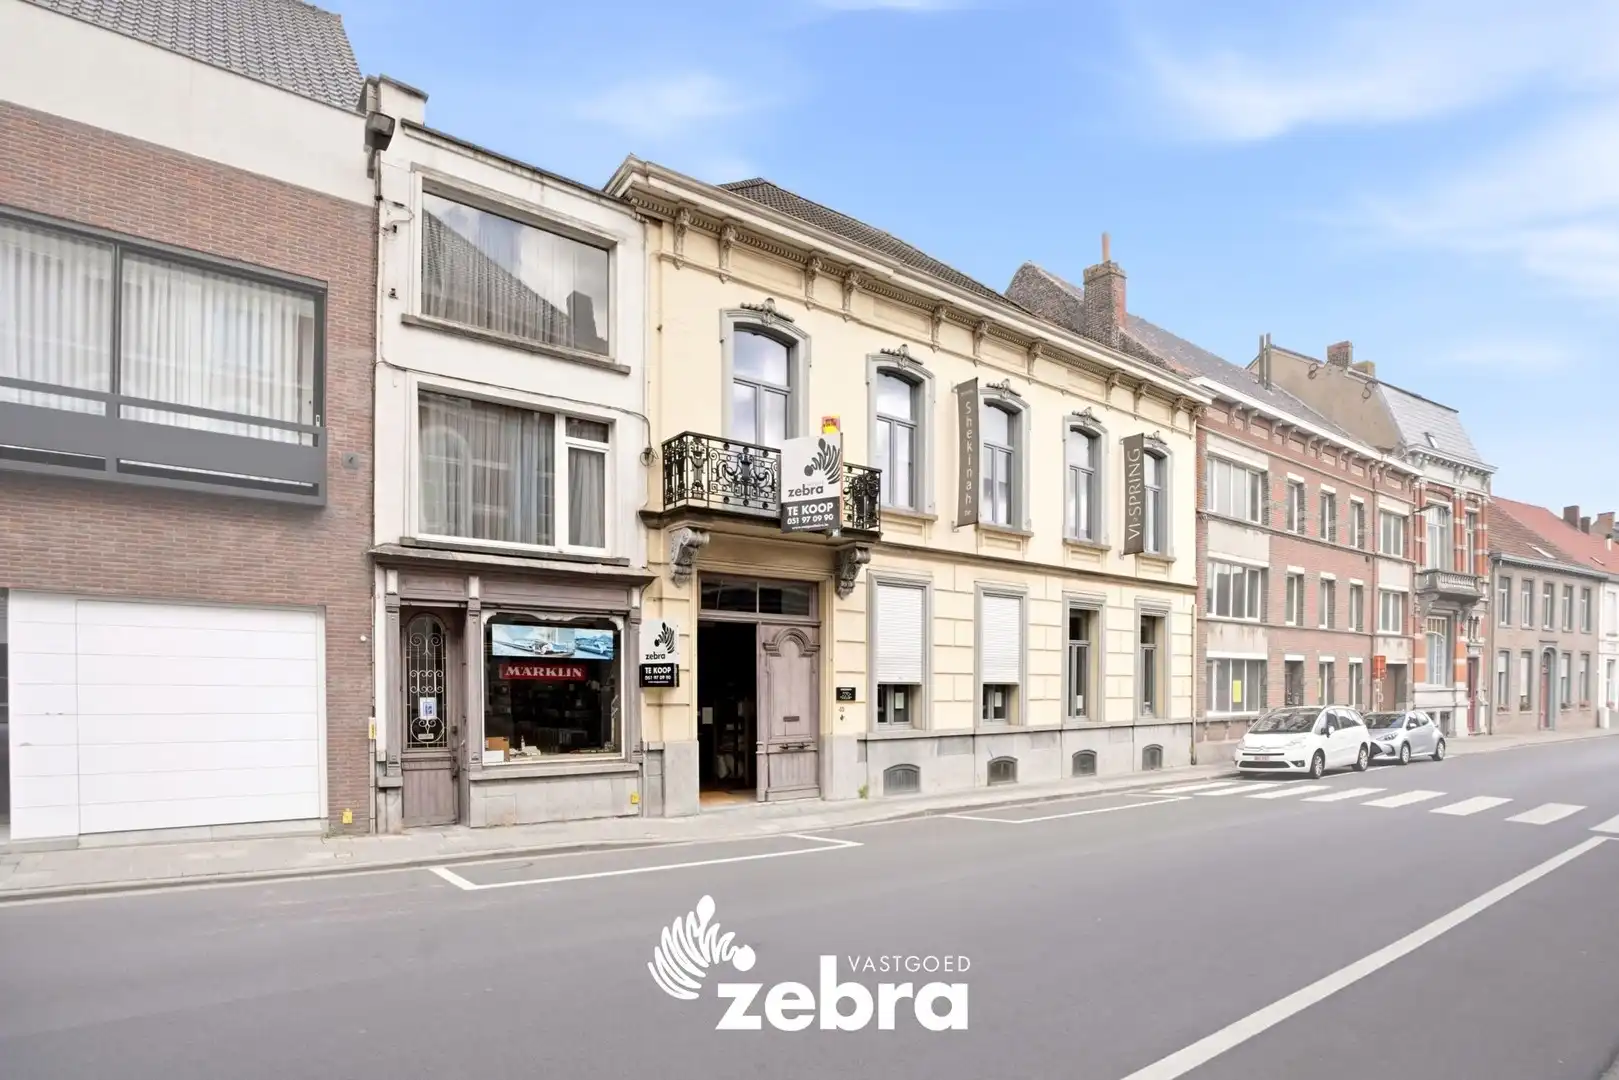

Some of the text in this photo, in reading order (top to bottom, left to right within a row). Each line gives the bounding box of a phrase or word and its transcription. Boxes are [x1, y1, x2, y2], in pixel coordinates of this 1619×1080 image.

[788, 484, 824, 497] zebra
[787, 502, 834, 516] TE KOOP
[787, 517, 800, 525] 051
[801, 516, 811, 524] 97
[812, 515, 822, 523] 09
[645, 651, 665, 660] zebra
[653, 666, 671, 674] KOOP
